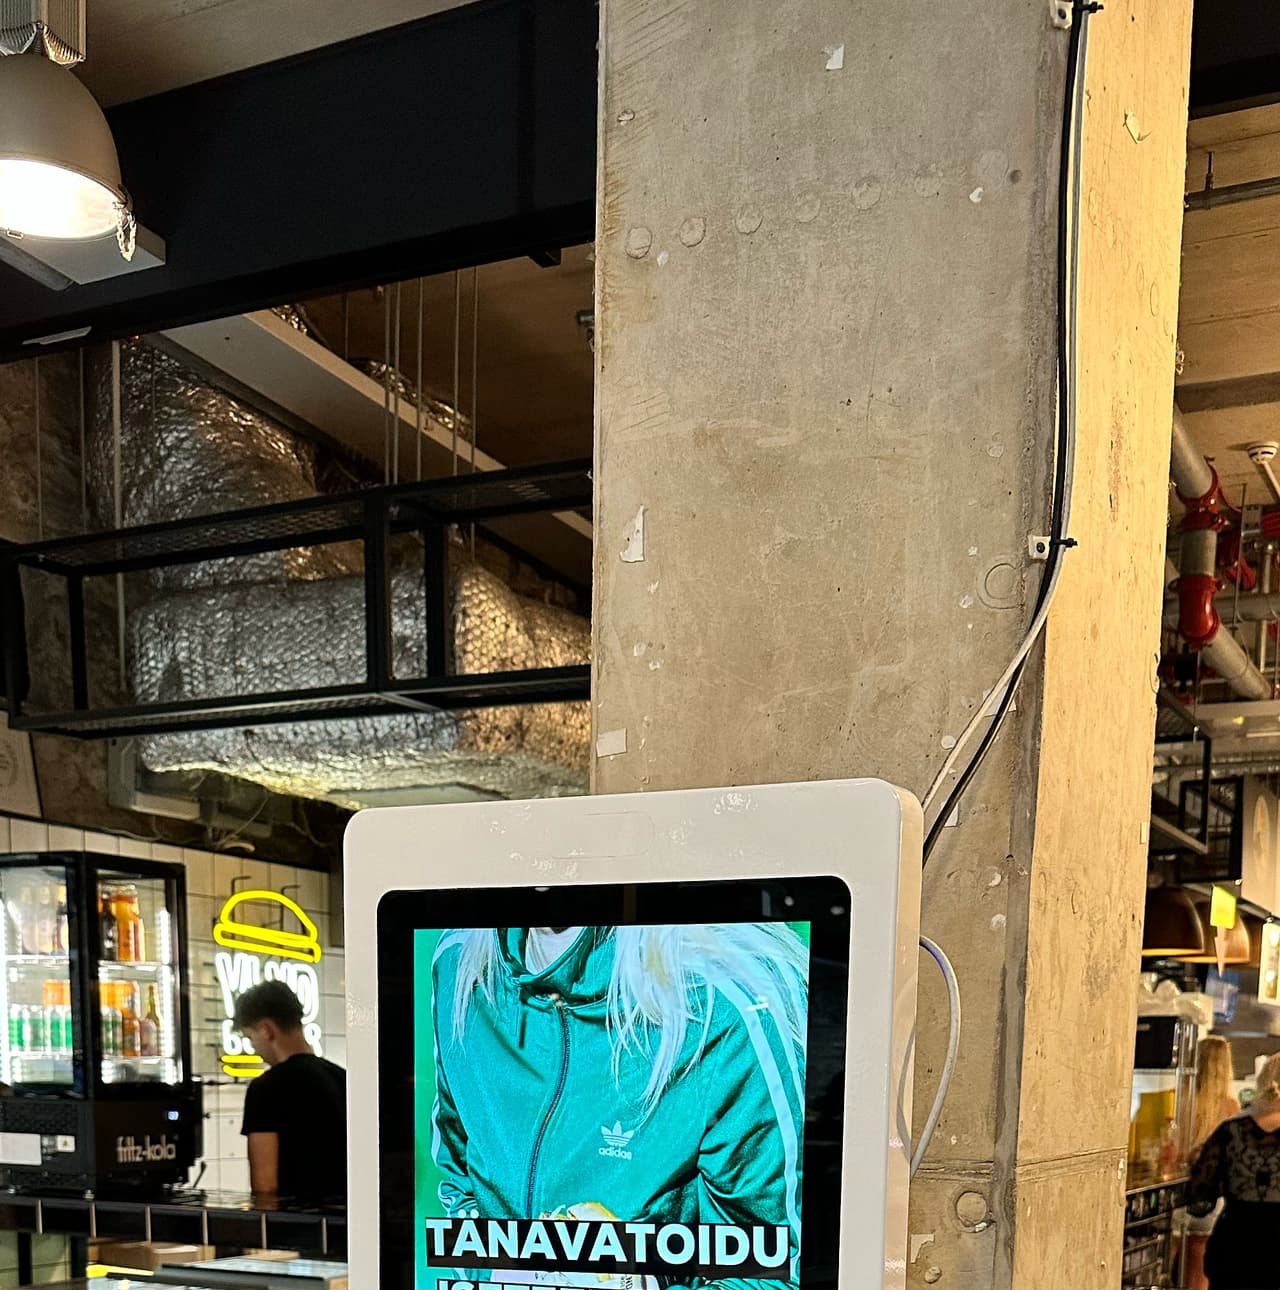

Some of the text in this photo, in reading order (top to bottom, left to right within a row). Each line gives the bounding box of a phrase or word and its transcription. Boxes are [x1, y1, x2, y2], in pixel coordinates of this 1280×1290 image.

[117, 1133, 176, 1163] fritz-kola
[598, 1146, 633, 1160] adidas
[426, 1209, 788, 1268] TÄNAVATOIDU
